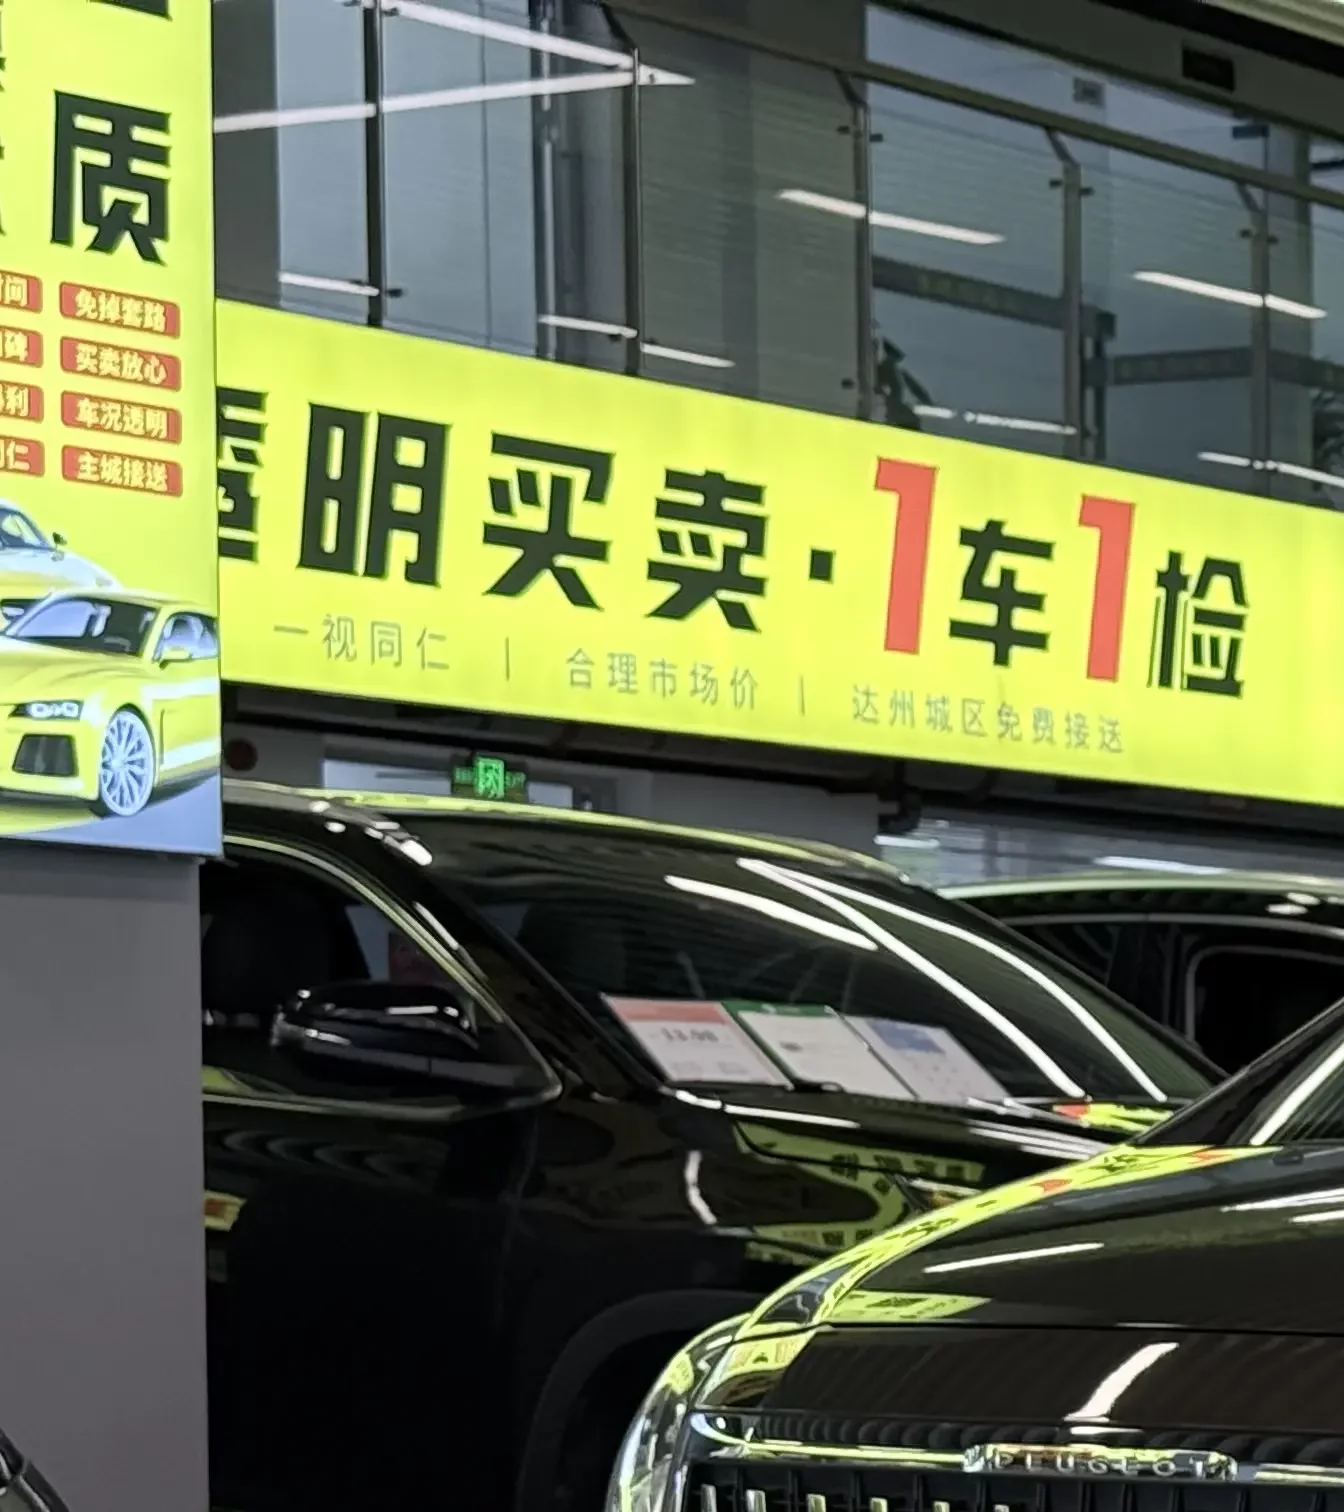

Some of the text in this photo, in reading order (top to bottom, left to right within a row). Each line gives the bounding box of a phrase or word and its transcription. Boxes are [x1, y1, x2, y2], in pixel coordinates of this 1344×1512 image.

[51, 90, 171, 266] 质
[75, 342, 167, 385] 买卖放心
[76, 397, 168, 439] 车况透明
[274, 613, 1123, 753] 一视同仁 合理市场价 达州城区免费接送
